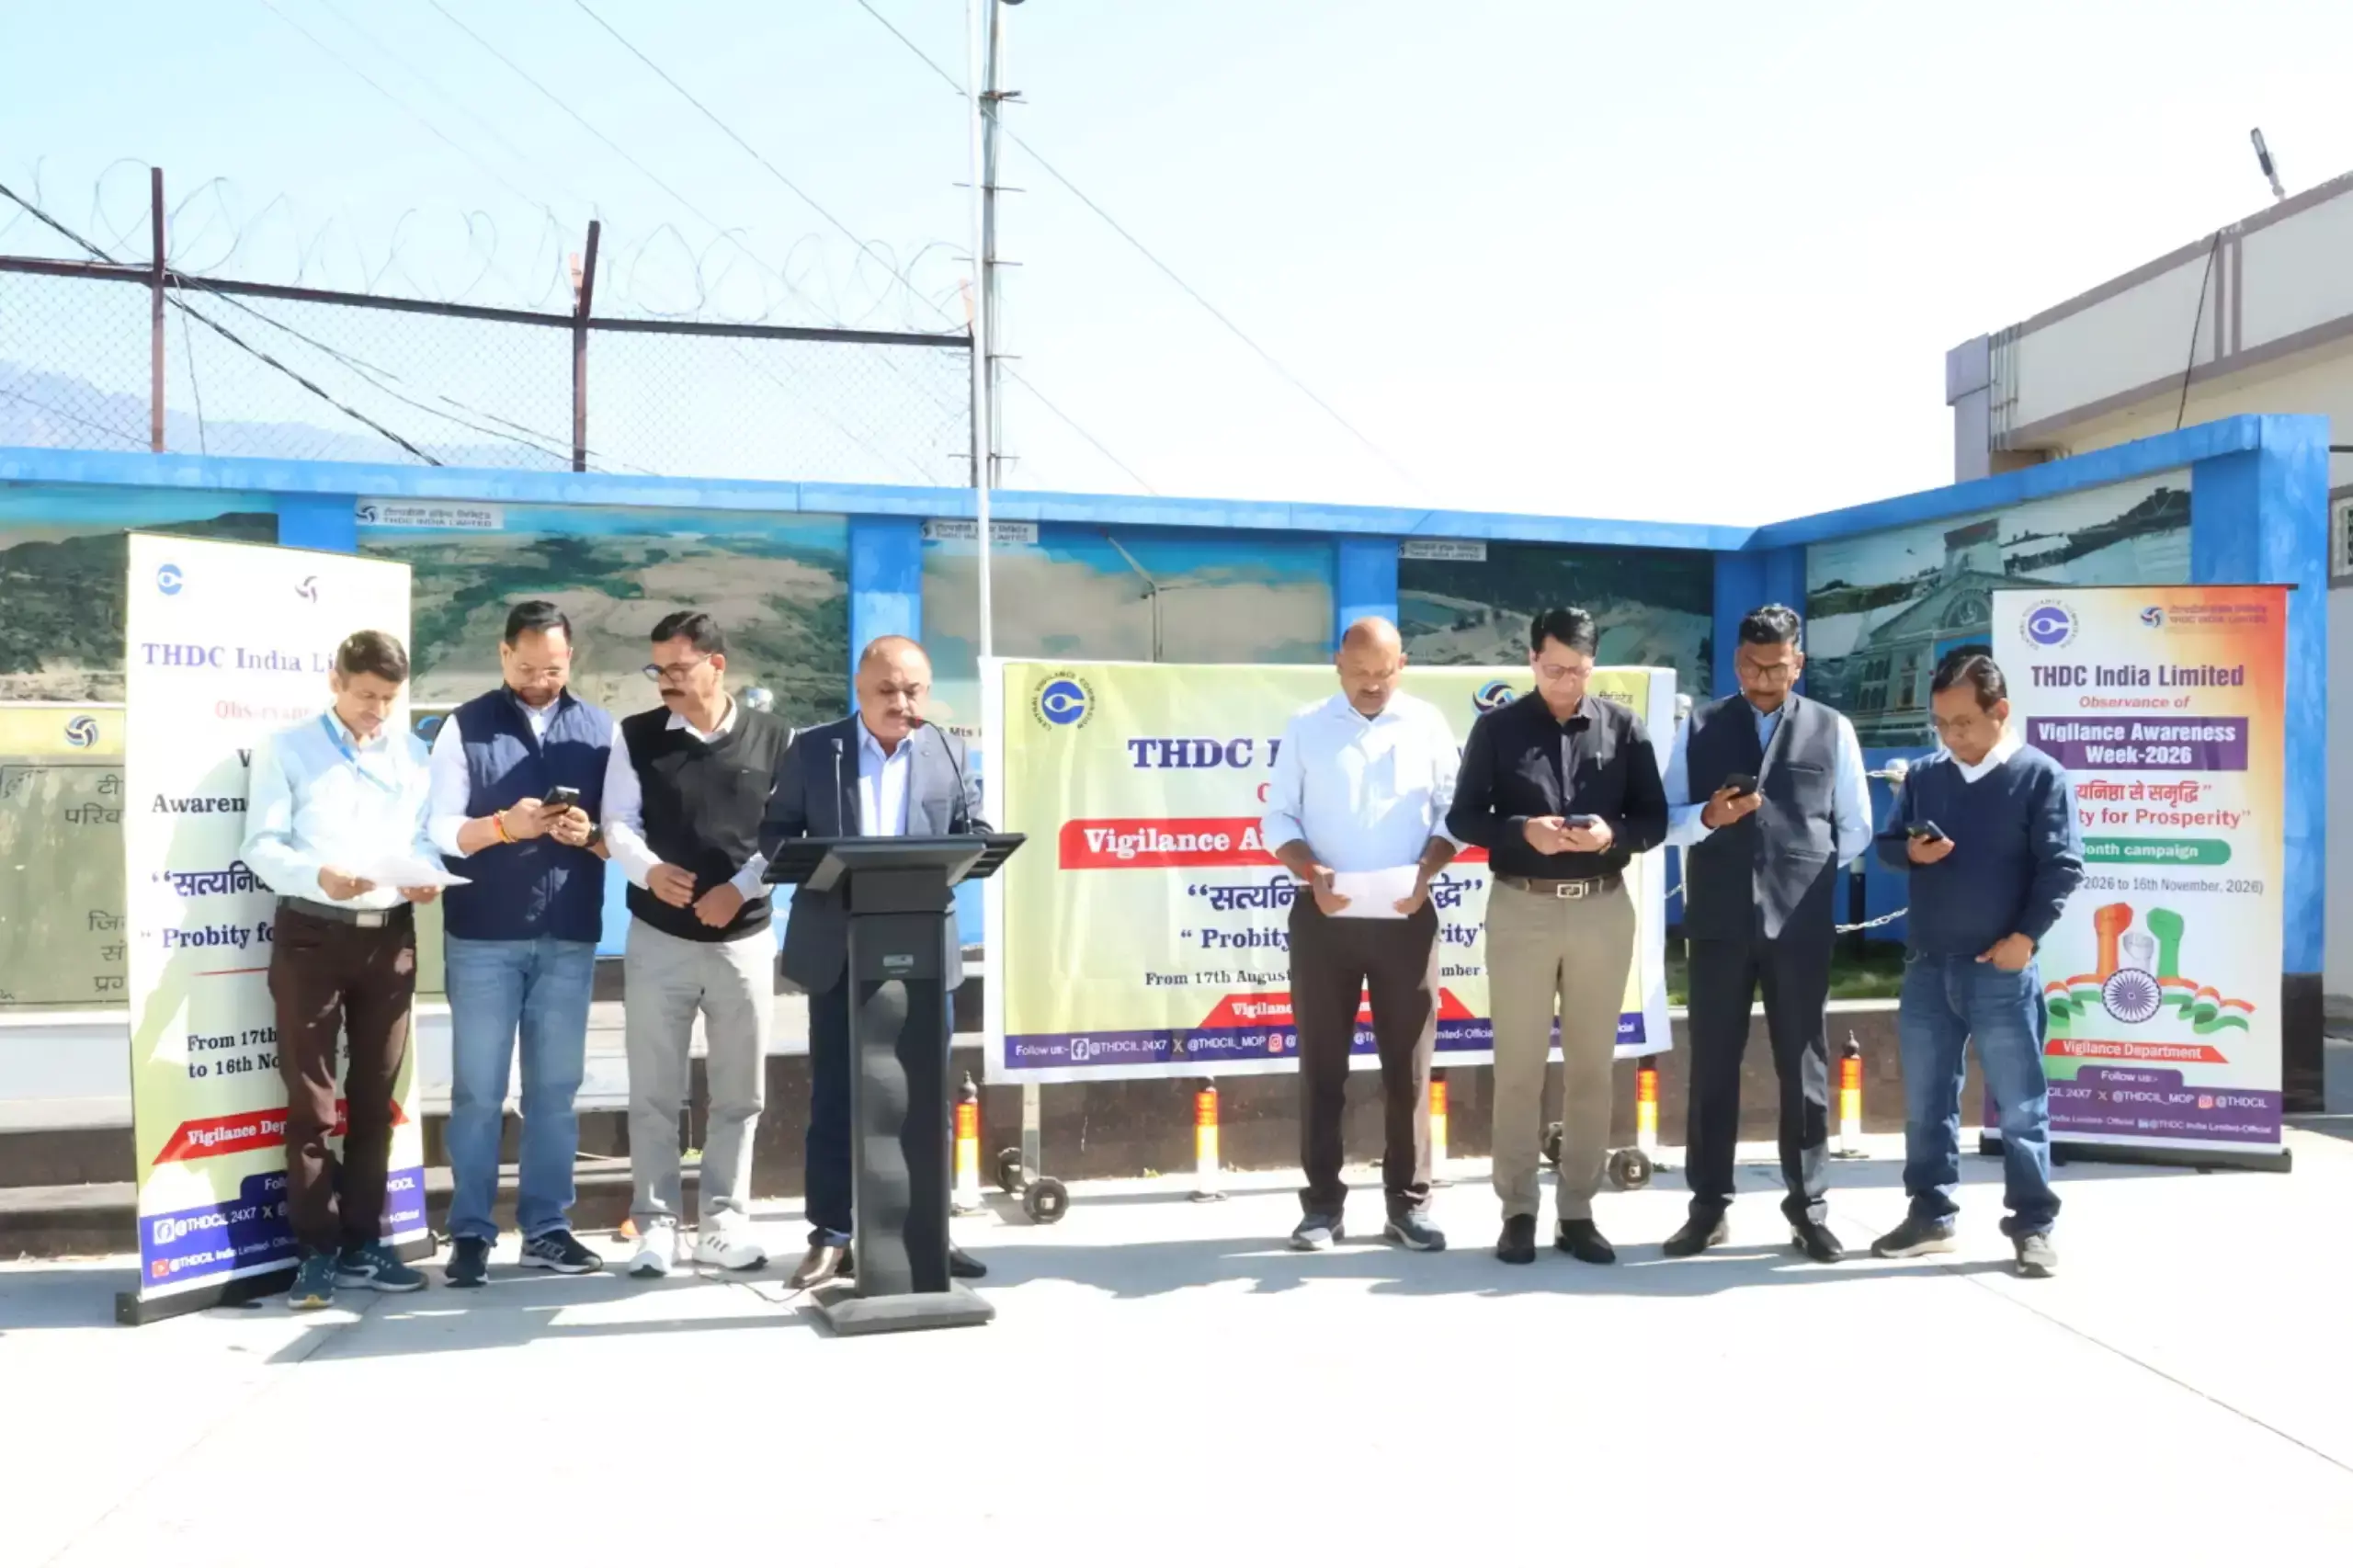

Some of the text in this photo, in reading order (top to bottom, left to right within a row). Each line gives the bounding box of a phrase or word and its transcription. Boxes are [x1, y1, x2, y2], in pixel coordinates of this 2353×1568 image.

[142, 642, 225, 668] THDC
[235, 647, 301, 672] India
[2031, 665, 2245, 687] THDC India Limited
[2079, 696, 2191, 709] Observance of
[2038, 722, 2236, 743] Vigilance Awareness
[1128, 739, 1253, 768] THDC
[2085, 745, 2192, 765] Week-2026
[2129, 779, 2144, 801] से
[152, 793, 247, 813] Awaren
[2101, 808, 2128, 824] for
[1085, 829, 1230, 858] Vigilance
[2123, 846, 2199, 860] campaign
[2118, 879, 2129, 890] to
[2133, 879, 2158, 891] 16th
[162, 923, 251, 949] Probity
[1146, 972, 1188, 985] From
[1196, 971, 1230, 984] 17th
[188, 1035, 235, 1051] From
[1016, 1045, 1049, 1057] Follow
[2063, 1040, 2201, 1060] Vigilance Department
[189, 1062, 208, 1078] to
[216, 1056, 253, 1075] 16th
[2101, 1071, 2135, 1082] Follow
[187, 1126, 256, 1147] Vigilance
